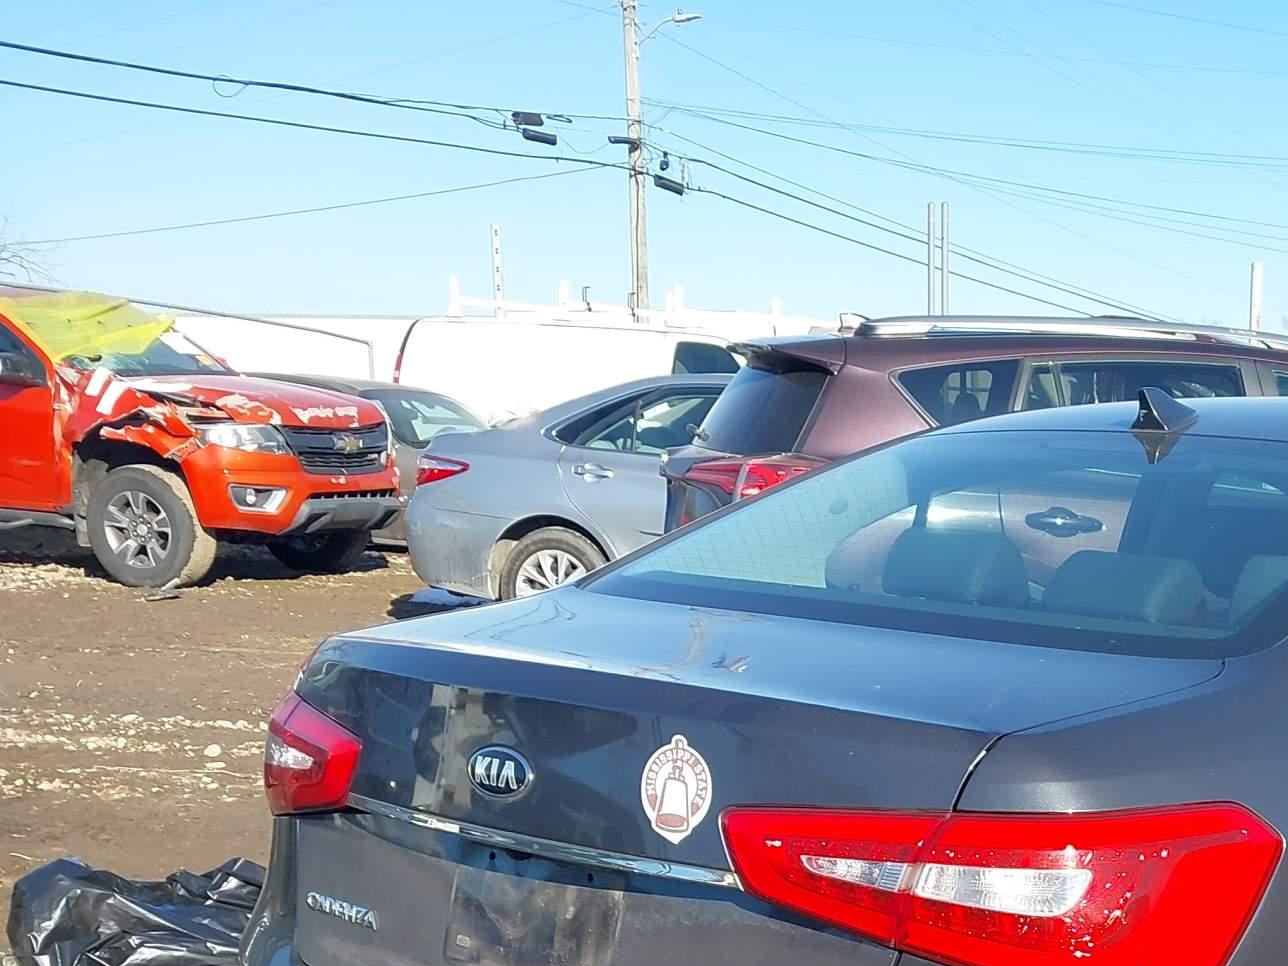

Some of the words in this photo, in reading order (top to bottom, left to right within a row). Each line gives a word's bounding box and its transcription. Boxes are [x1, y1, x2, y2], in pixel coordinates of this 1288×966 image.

[474, 755, 518, 790] KIA
[645, 747, 697, 796] MISSISSIPPI
[691, 764, 708, 804] STATE
[306, 891, 378, 931] CADENZA
